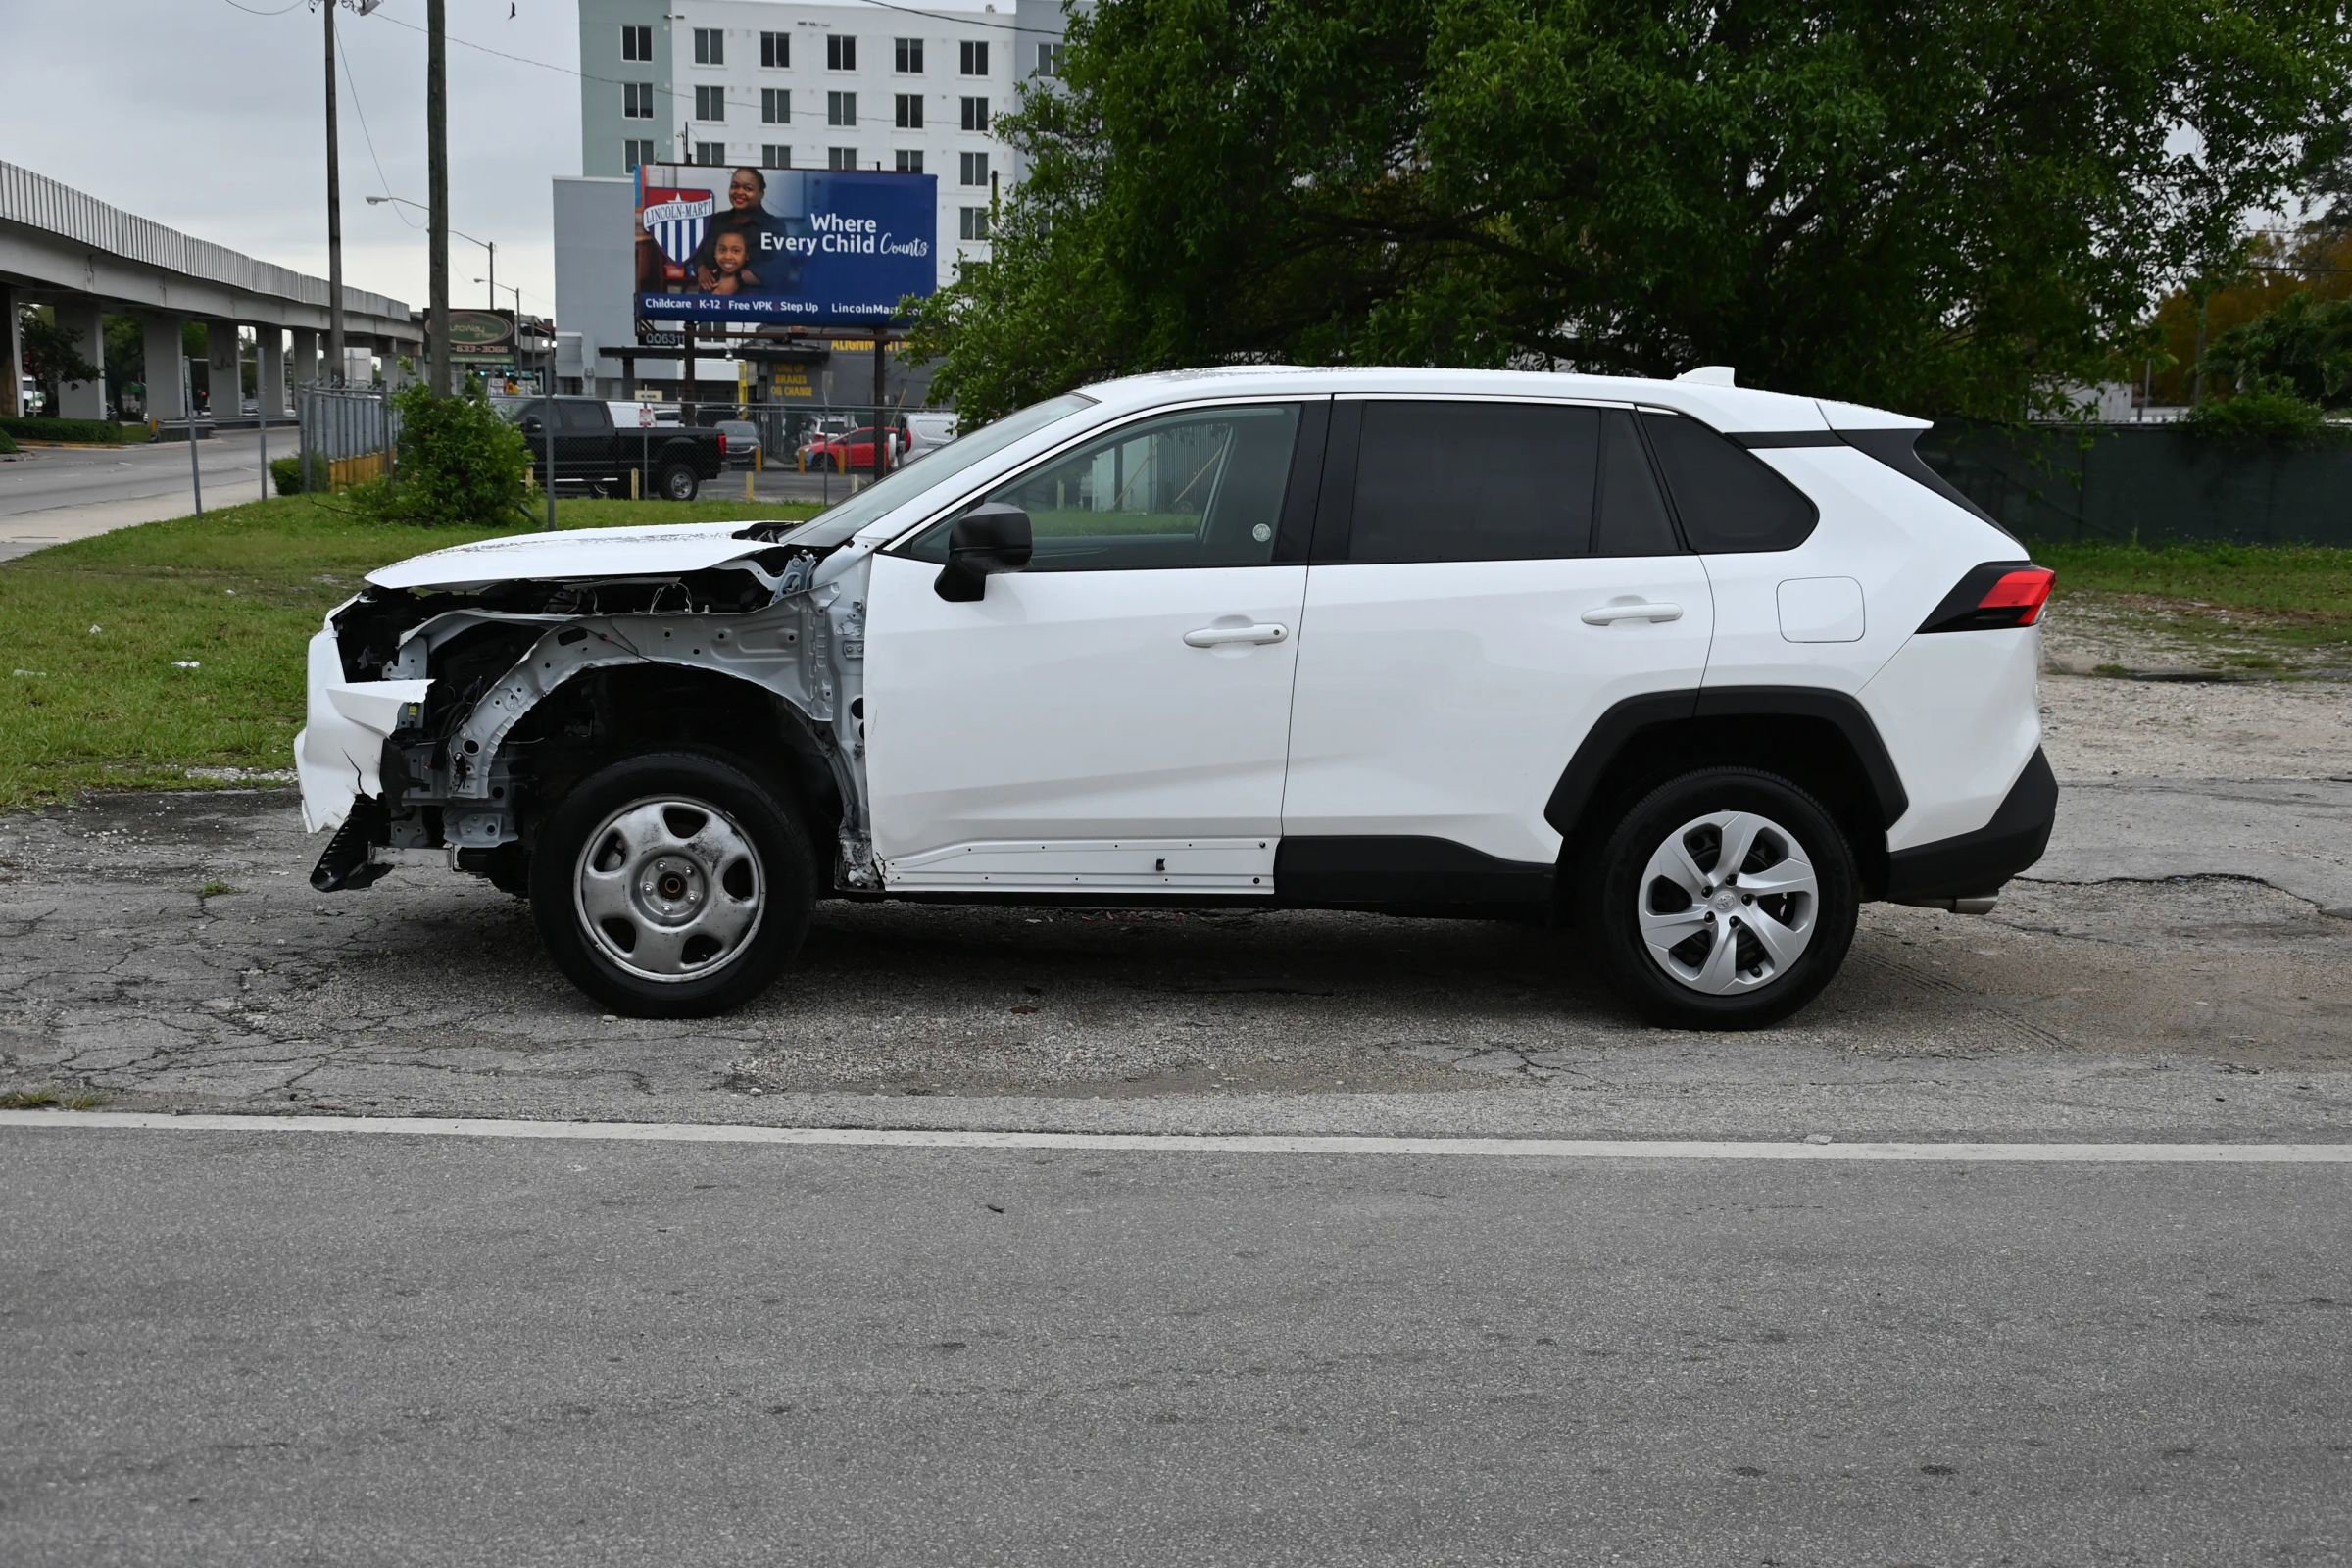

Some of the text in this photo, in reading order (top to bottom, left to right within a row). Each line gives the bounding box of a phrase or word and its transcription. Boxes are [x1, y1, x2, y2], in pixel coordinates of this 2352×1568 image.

[645, 200, 711, 224] LINCOLN-MARTI
[810, 213, 877, 233] Where
[760, 231, 928, 257] Every Child Counts
[645, 298, 692, 309] Childcare
[699, 299, 721, 310] K-12
[728, 300, 750, 311] Free
[752, 301, 773, 311] VPK
[780, 301, 803, 313] Step
[805, 302, 819, 314] Up
[775, 374, 808, 384] BRAKES
[784, 386, 812, 397] CHANGE
